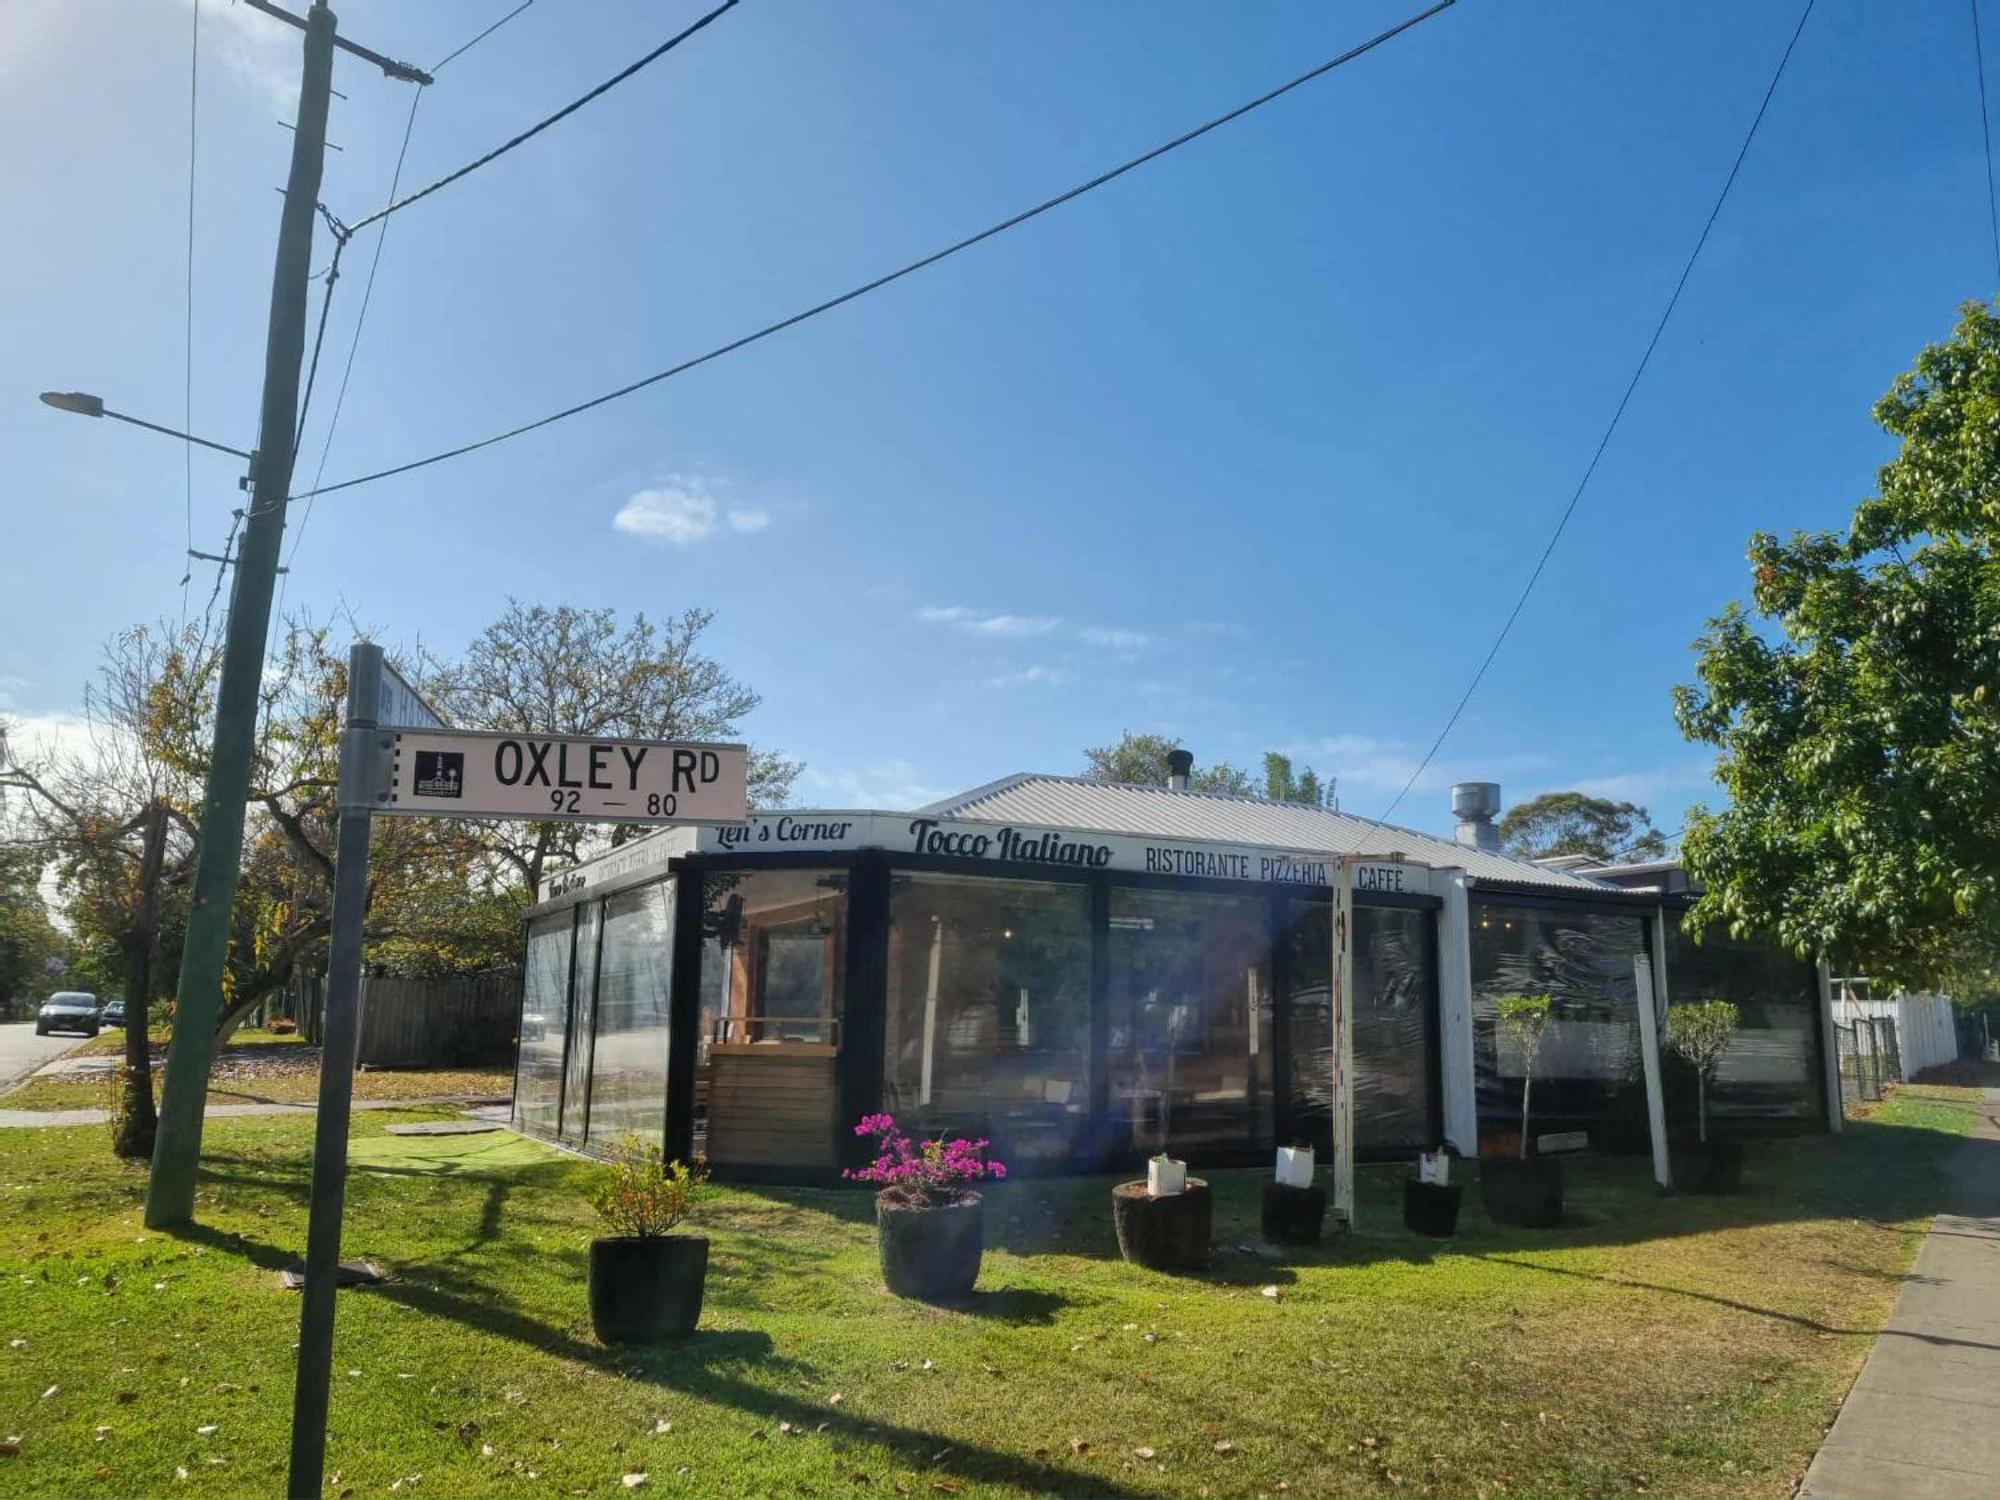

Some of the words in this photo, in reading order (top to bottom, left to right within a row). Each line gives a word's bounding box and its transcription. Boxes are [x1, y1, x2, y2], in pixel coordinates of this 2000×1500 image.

[495, 740, 649, 791] OXLEY
[672, 749, 720, 793] RD
[551, 790, 581, 814] 92
[647, 793, 677, 816] 80
[777, 816, 852, 842] Corner
[910, 819, 992, 857] Tocco
[997, 827, 1115, 866] Italiano
[1146, 847, 1249, 879] RISTORANTE
[1261, 857, 1327, 885] PIZZERIA
